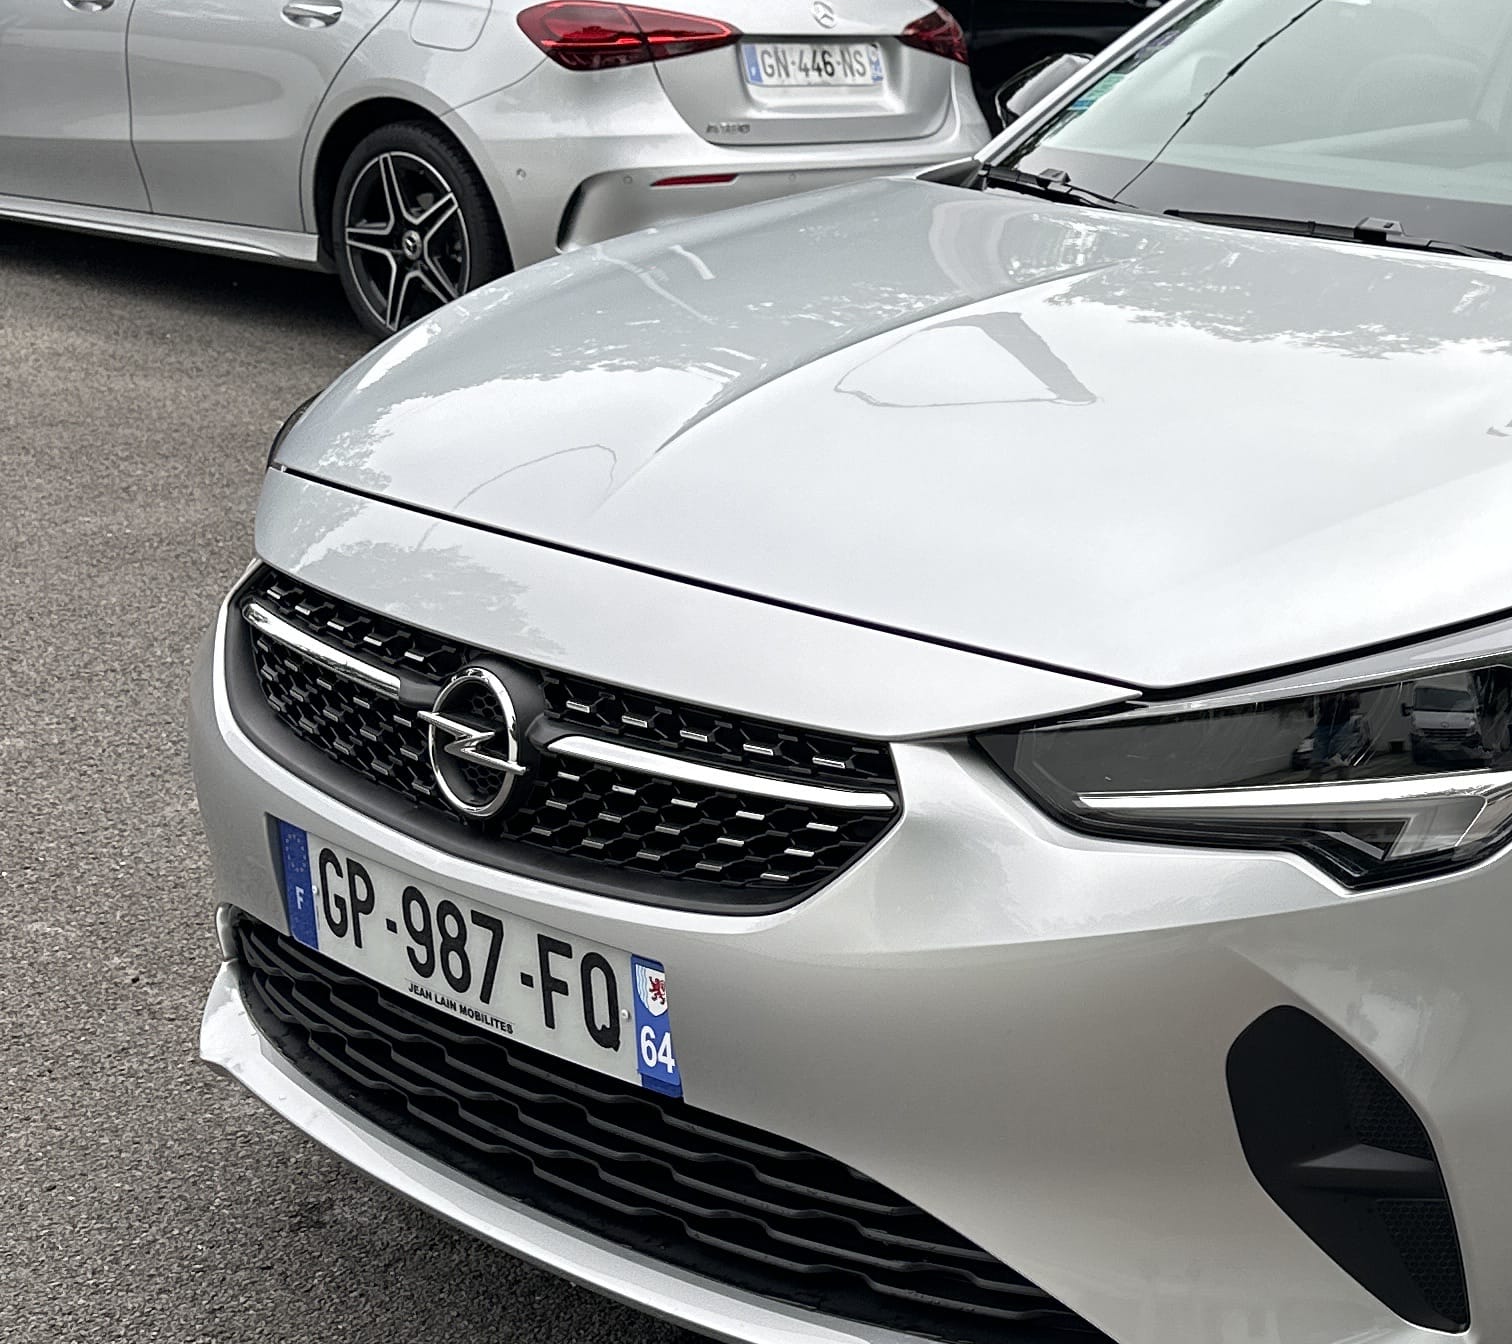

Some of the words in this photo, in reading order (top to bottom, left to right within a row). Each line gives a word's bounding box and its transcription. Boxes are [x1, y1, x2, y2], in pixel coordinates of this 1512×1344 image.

[761, 49, 866, 78] GN-446-NS
[295, 886, 305, 910] F
[318, 847, 621, 1052] GP-987-FQ
[408, 983, 432, 1001] JEAN
[434, 994, 457, 1011] LAIN
[459, 1004, 514, 1034] MOBILITES
[640, 1025, 675, 1074] 64
